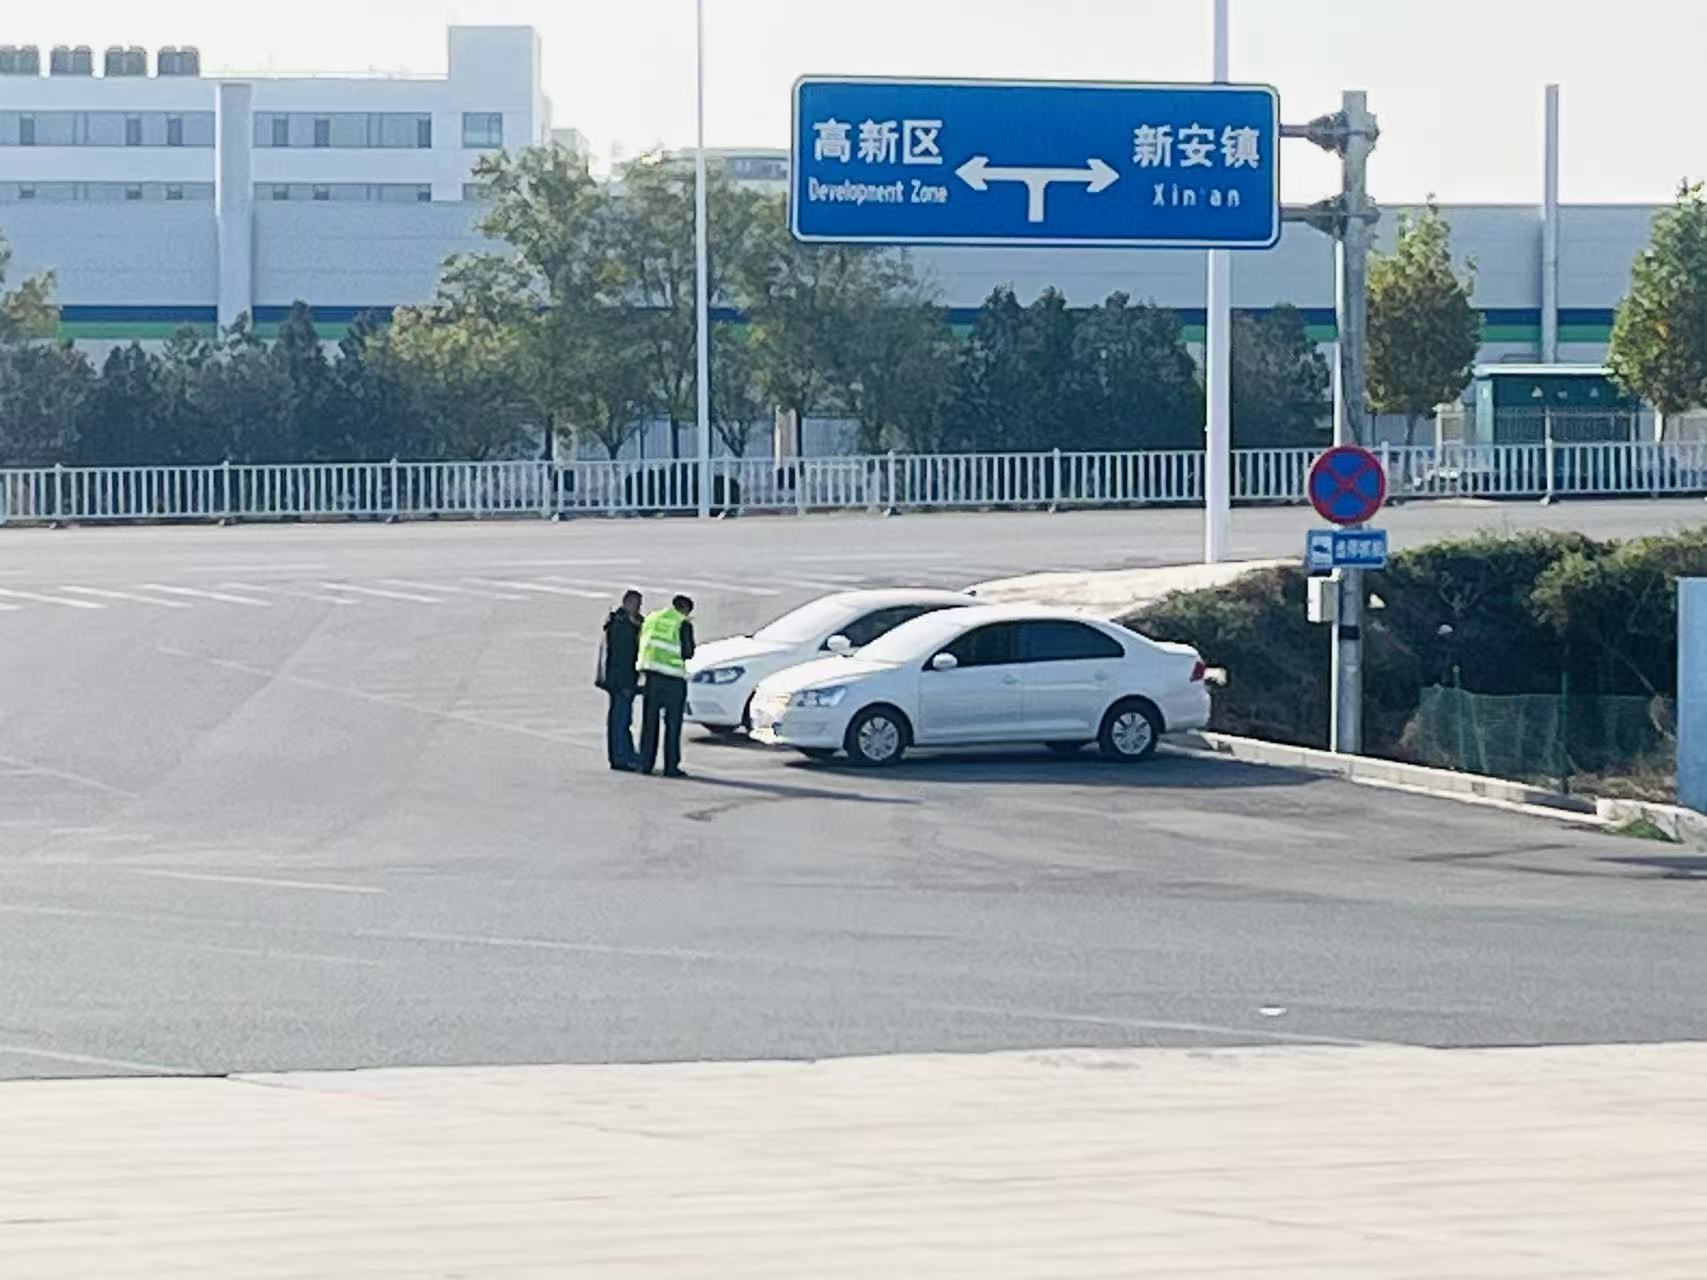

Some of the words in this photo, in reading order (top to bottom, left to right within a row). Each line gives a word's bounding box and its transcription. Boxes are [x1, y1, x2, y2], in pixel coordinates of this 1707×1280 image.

[813, 118, 943, 164] 高新区
[1132, 123, 1260, 169] 新安镇
[808, 177, 904, 205] Development
[910, 179, 948, 204] Zone
